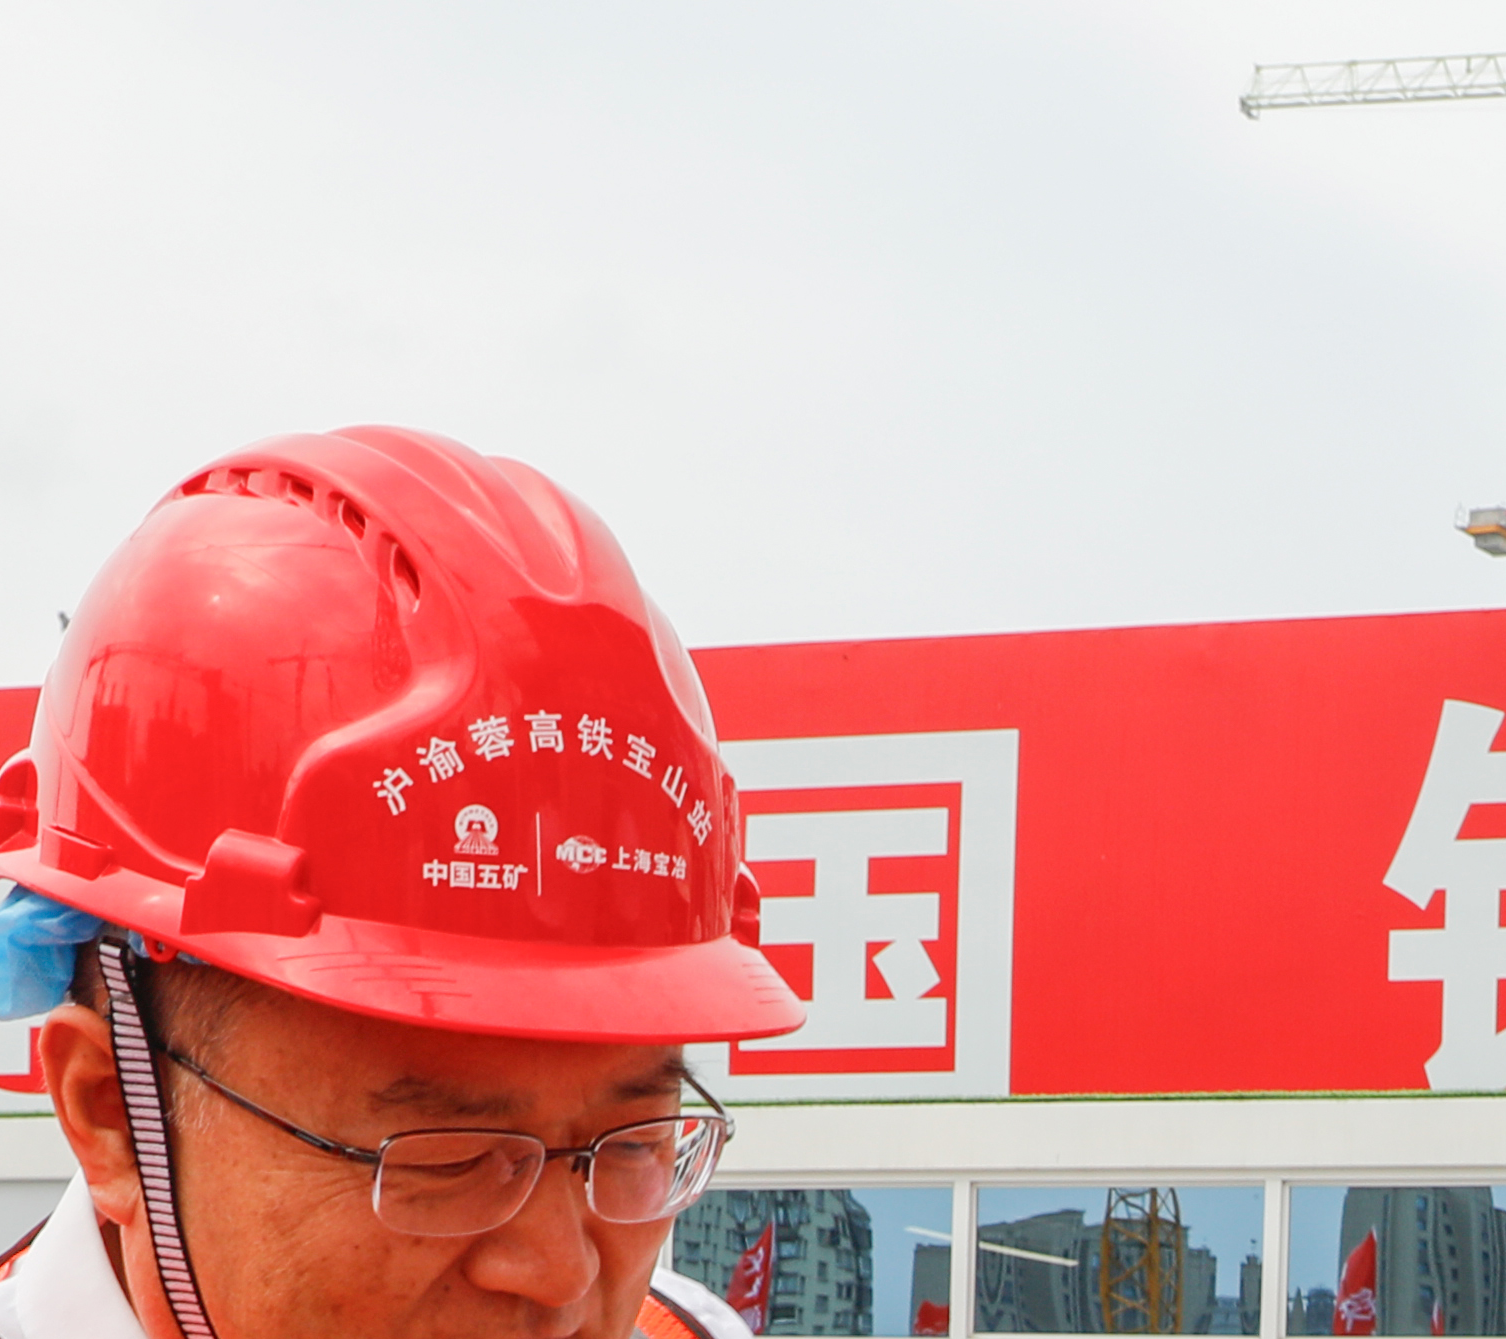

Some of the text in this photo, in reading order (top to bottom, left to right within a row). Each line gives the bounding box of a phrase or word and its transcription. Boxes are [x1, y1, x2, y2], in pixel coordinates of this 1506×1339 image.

[372, 709, 714, 847] 沪渝蓉高铁宝山站
[422, 859, 528, 891] 中国五矿
